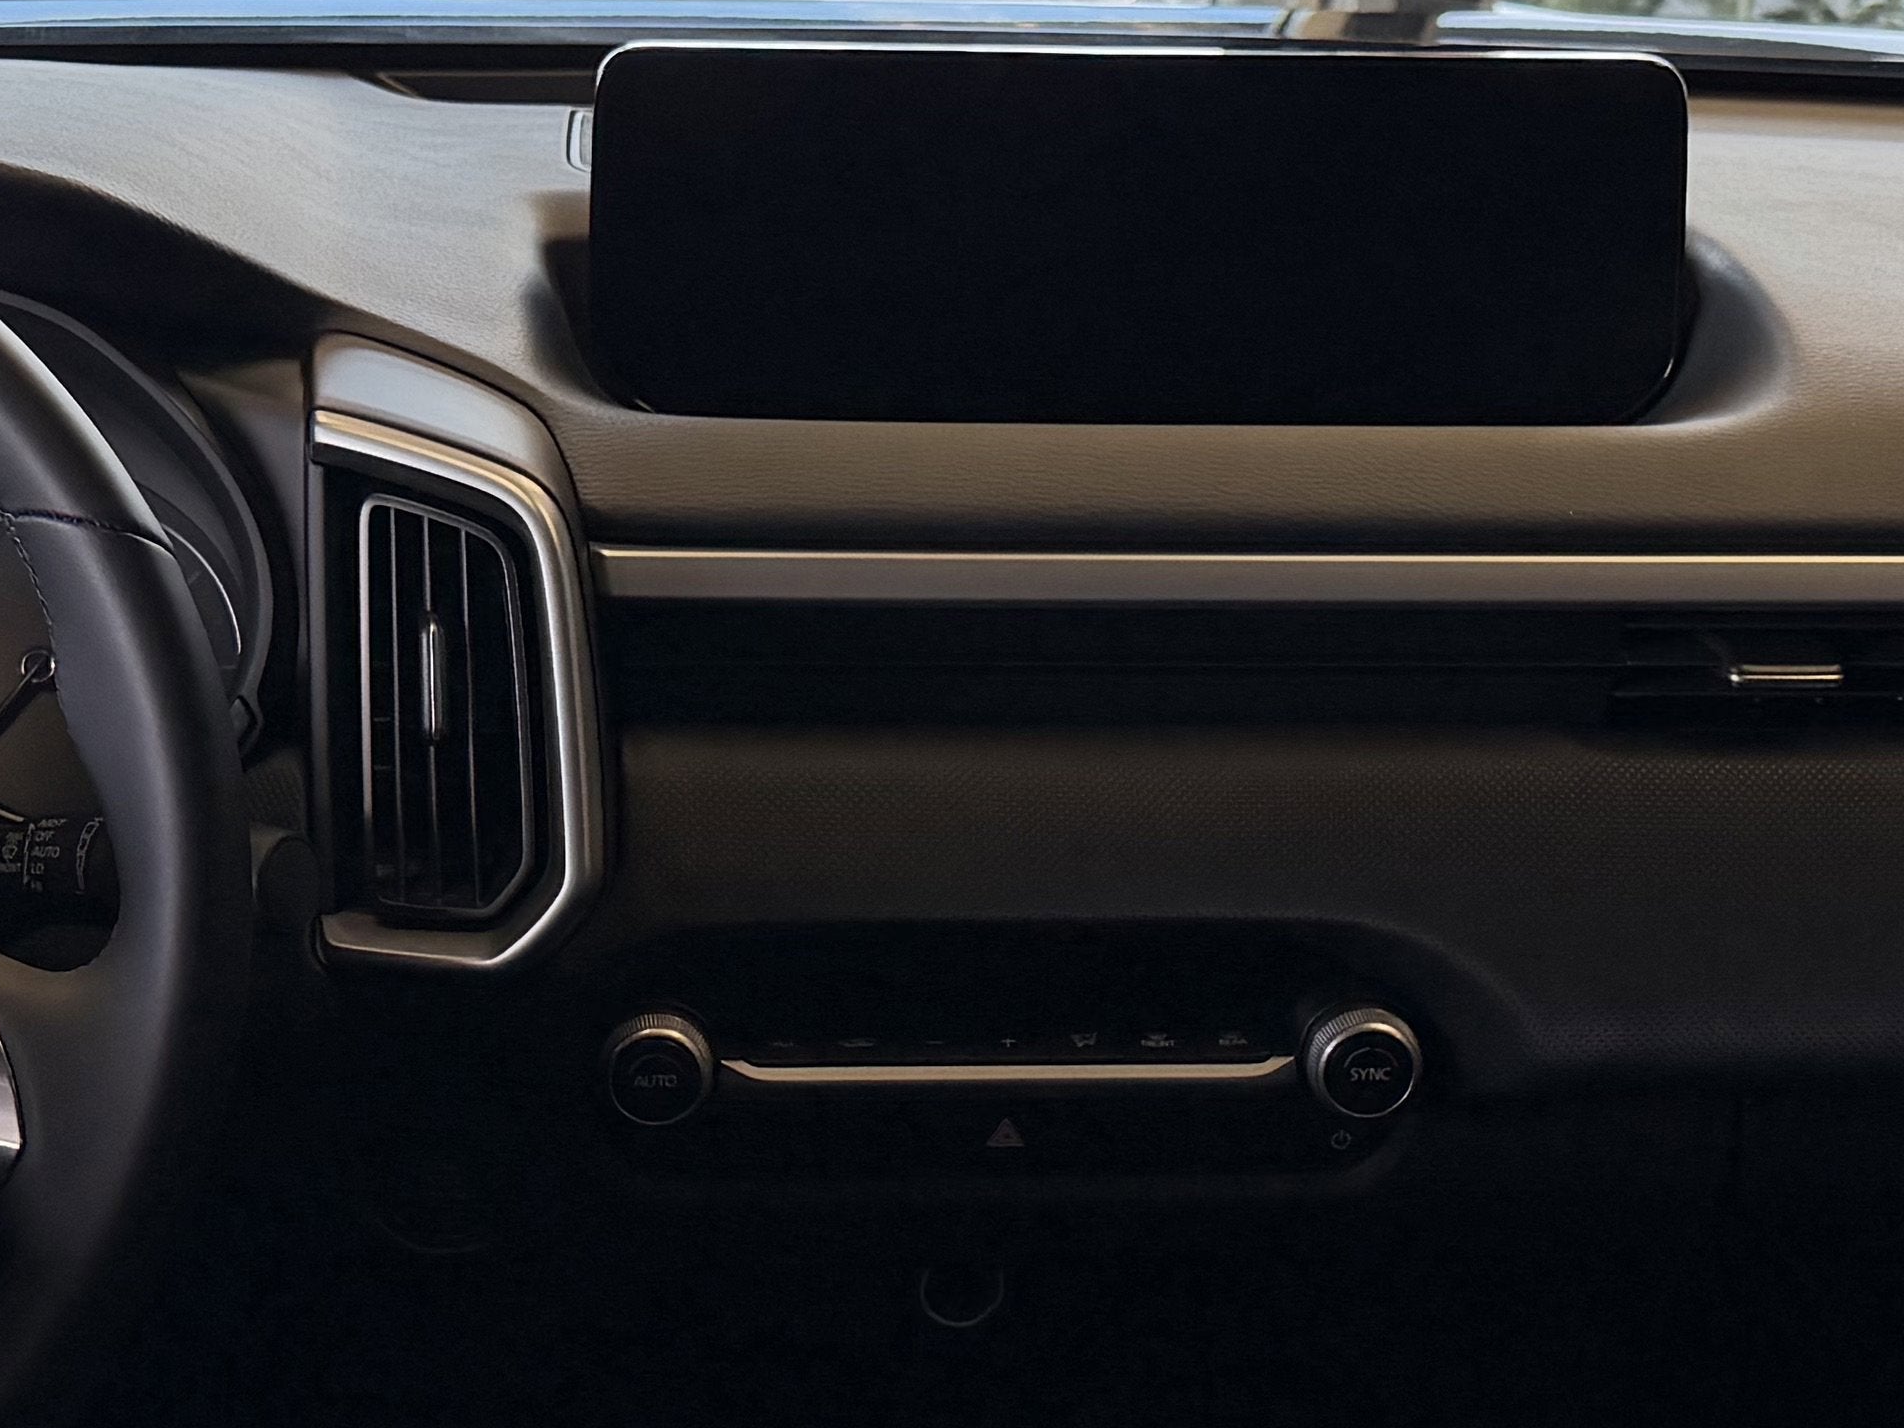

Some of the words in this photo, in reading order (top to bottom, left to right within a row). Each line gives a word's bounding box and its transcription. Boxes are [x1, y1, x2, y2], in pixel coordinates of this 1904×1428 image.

[31, 845, 60, 859] AUTO
[633, 1074, 678, 1089] AUTO
[1349, 1067, 1392, 1082] SYNC
